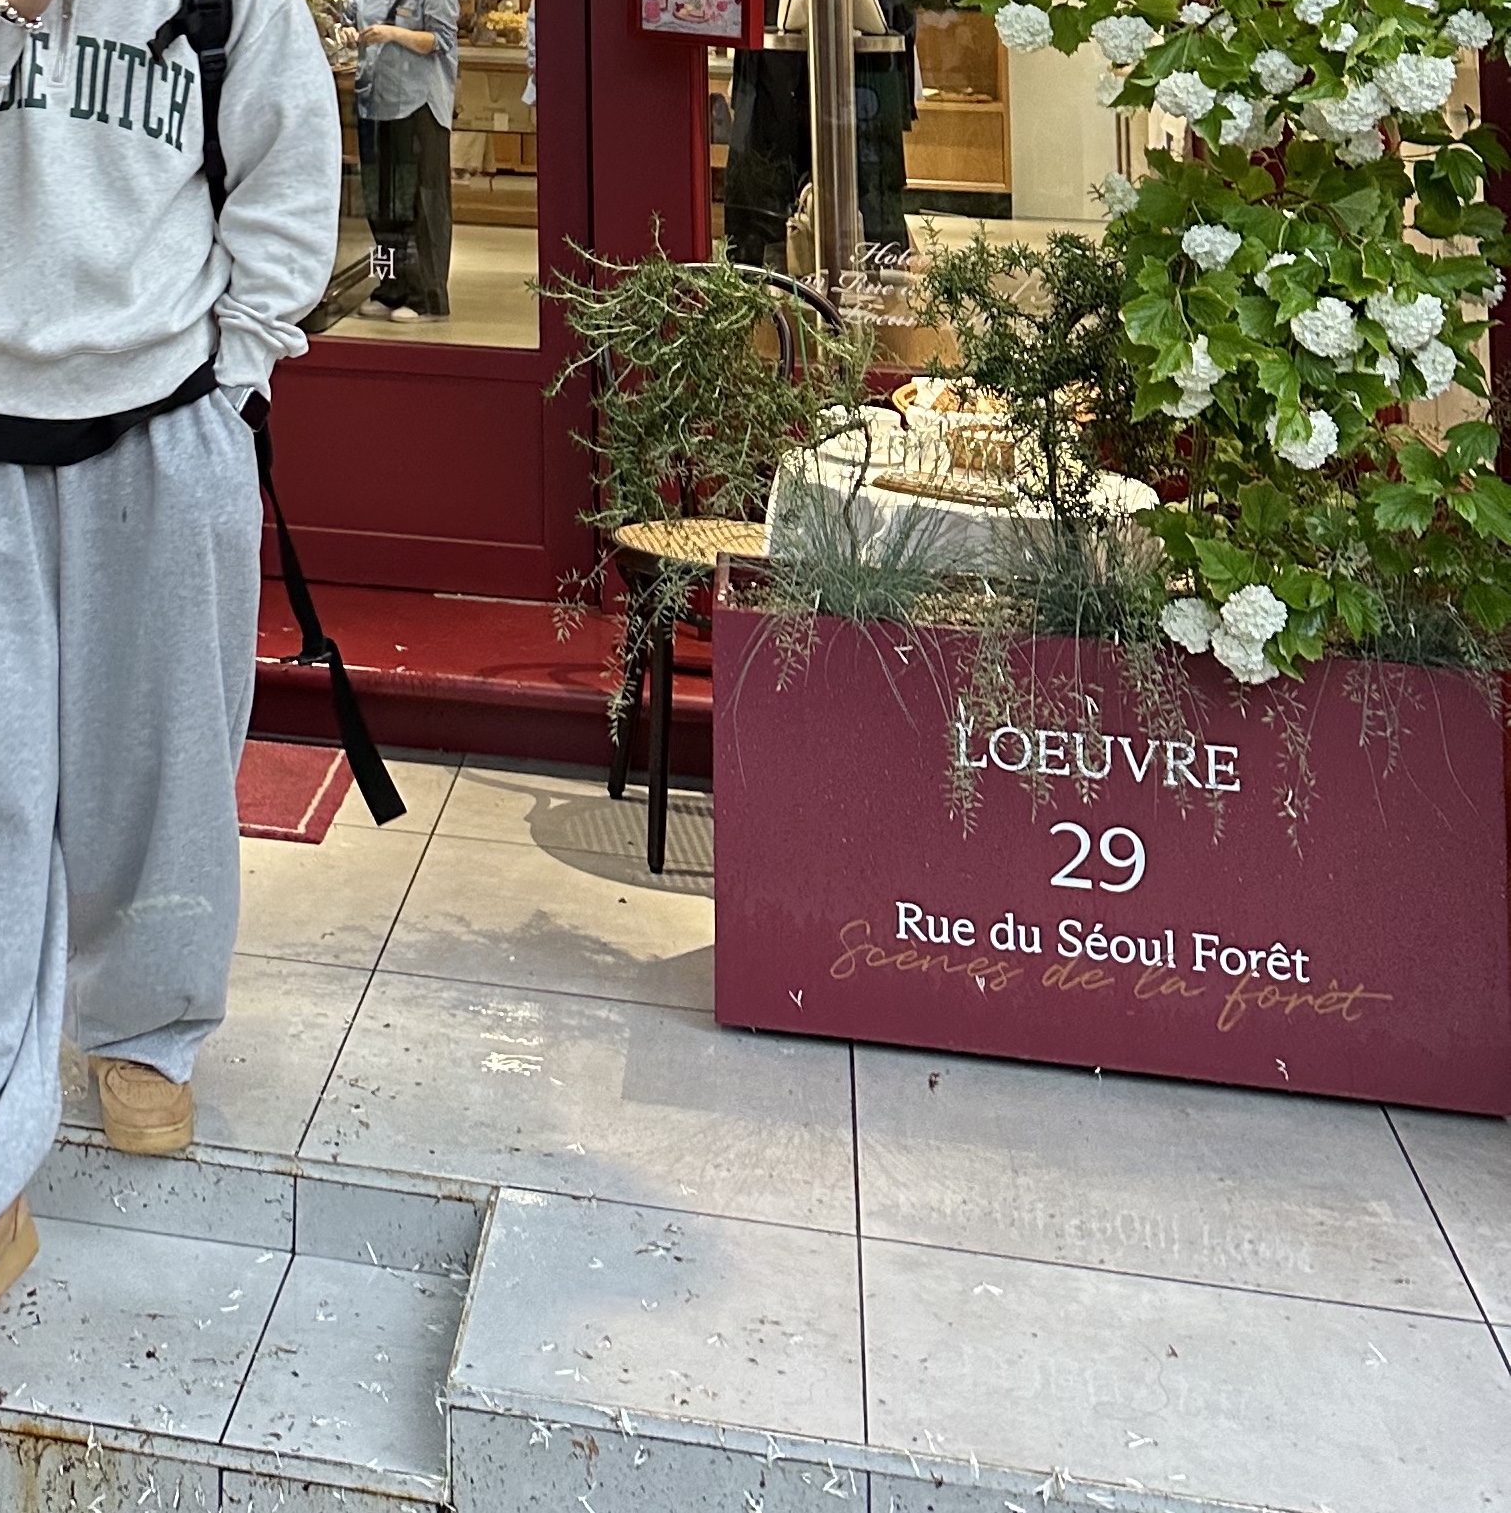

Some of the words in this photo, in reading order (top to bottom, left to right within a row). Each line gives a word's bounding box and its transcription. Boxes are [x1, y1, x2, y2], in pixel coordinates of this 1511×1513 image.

[70, 35, 195, 153] DITCH
[955, 721, 1241, 792] LOEUVRE
[1049, 821, 1147, 893] 29
[829, 919, 1024, 991] Scènes
[1041, 954, 1115, 990] de
[896, 901, 976, 946] Rue
[989, 912, 1042, 954] du
[1056, 919, 1176, 969] Séoul
[1191, 932, 1310, 983] Forêt
